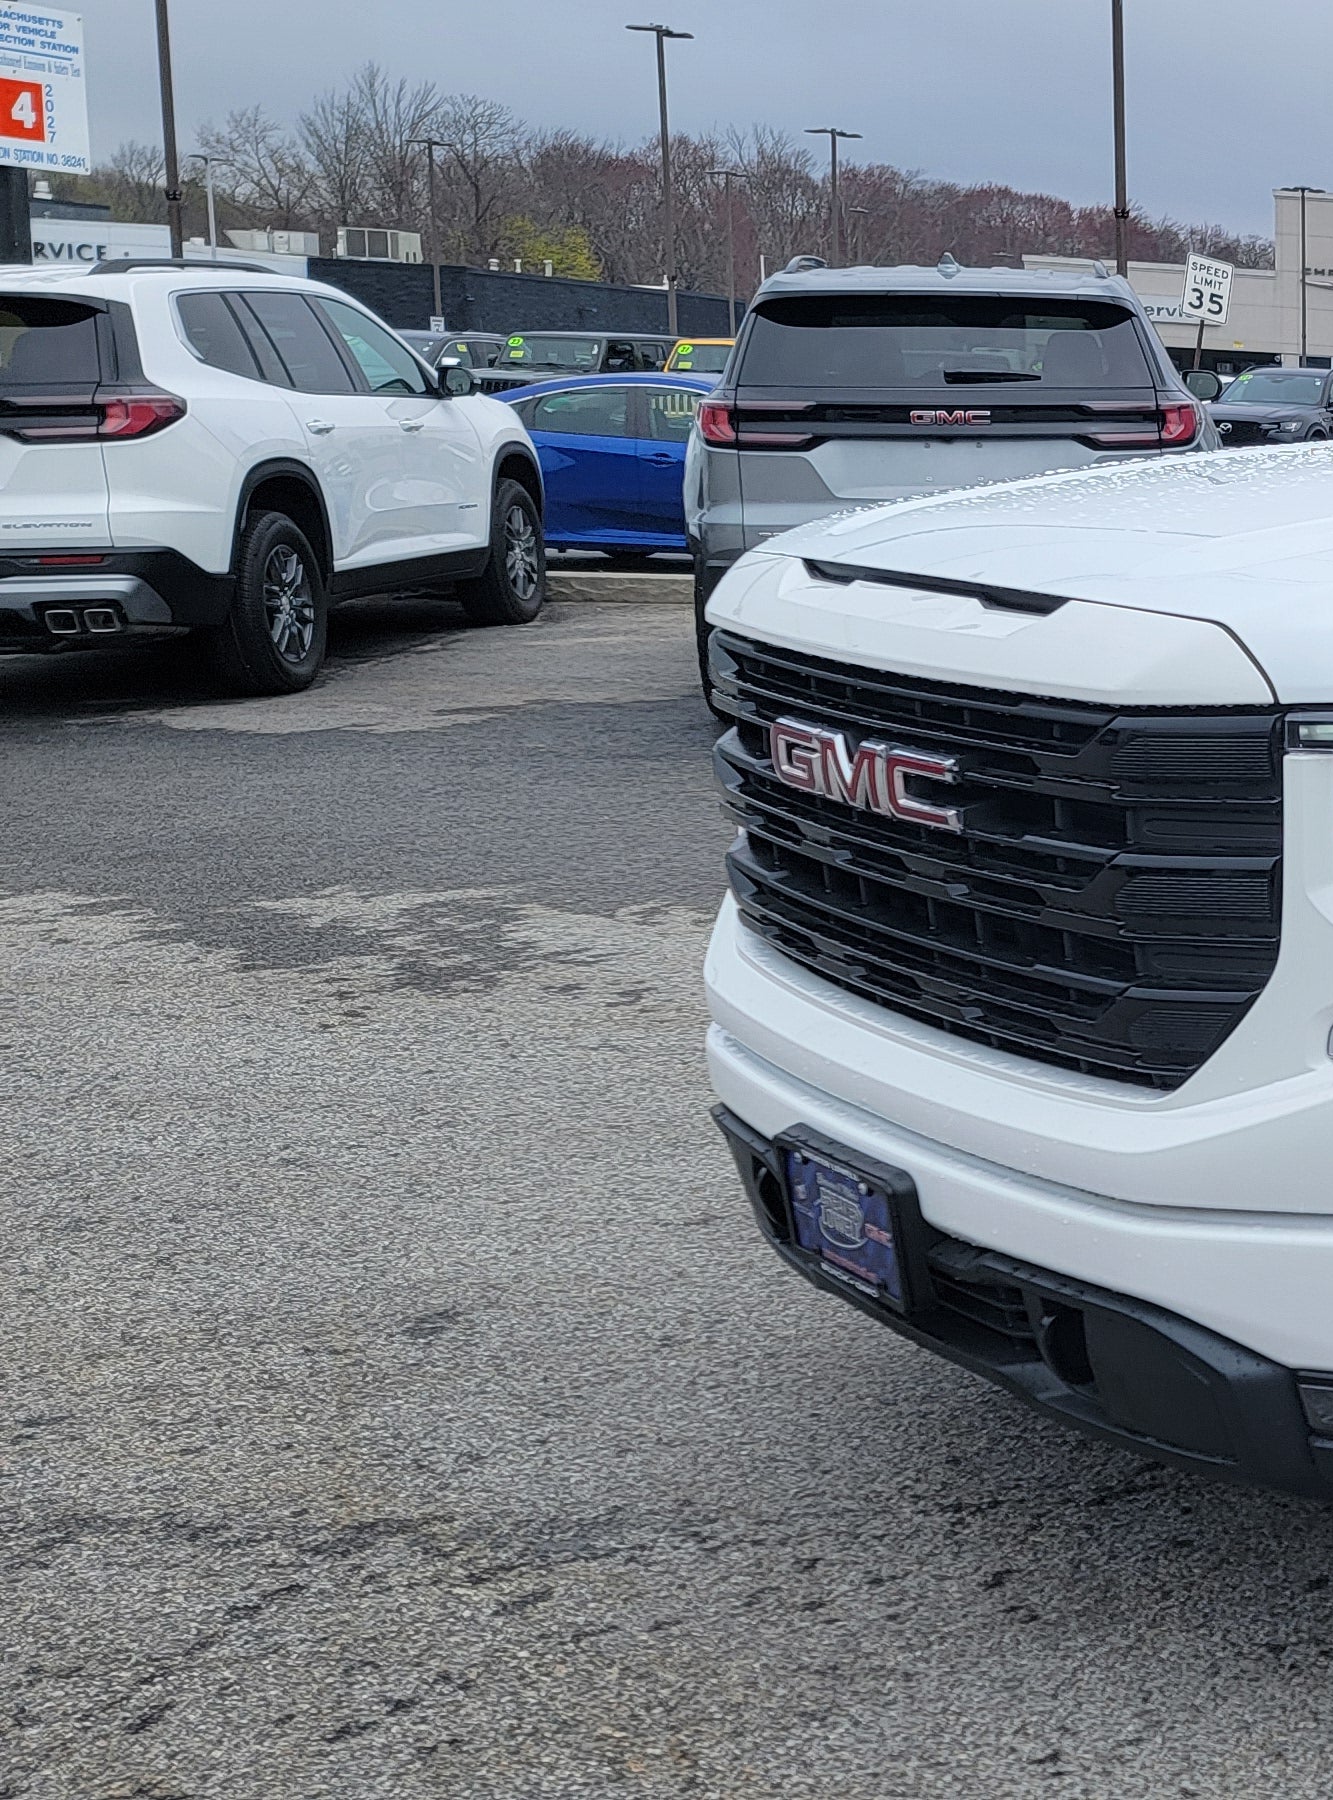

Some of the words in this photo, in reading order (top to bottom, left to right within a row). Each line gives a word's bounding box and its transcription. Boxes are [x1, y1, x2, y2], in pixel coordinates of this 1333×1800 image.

[15, 25, 57, 39] VEHICLE
[0, 34, 35, 47] ECTION
[40, 41, 79, 54] STATION
[11, 91, 36, 129] 4
[14, 149, 44, 163] STATION
[33, 241, 108, 260] RVICE
[1191, 261, 1229, 280] SPEED
[1193, 275, 1223, 290] LIMIT
[1187, 287, 1224, 315] 35
[910, 410, 991, 425] GMC
[2, 522, 93, 530] ELEVATION
[770, 715, 966, 835] GMC
